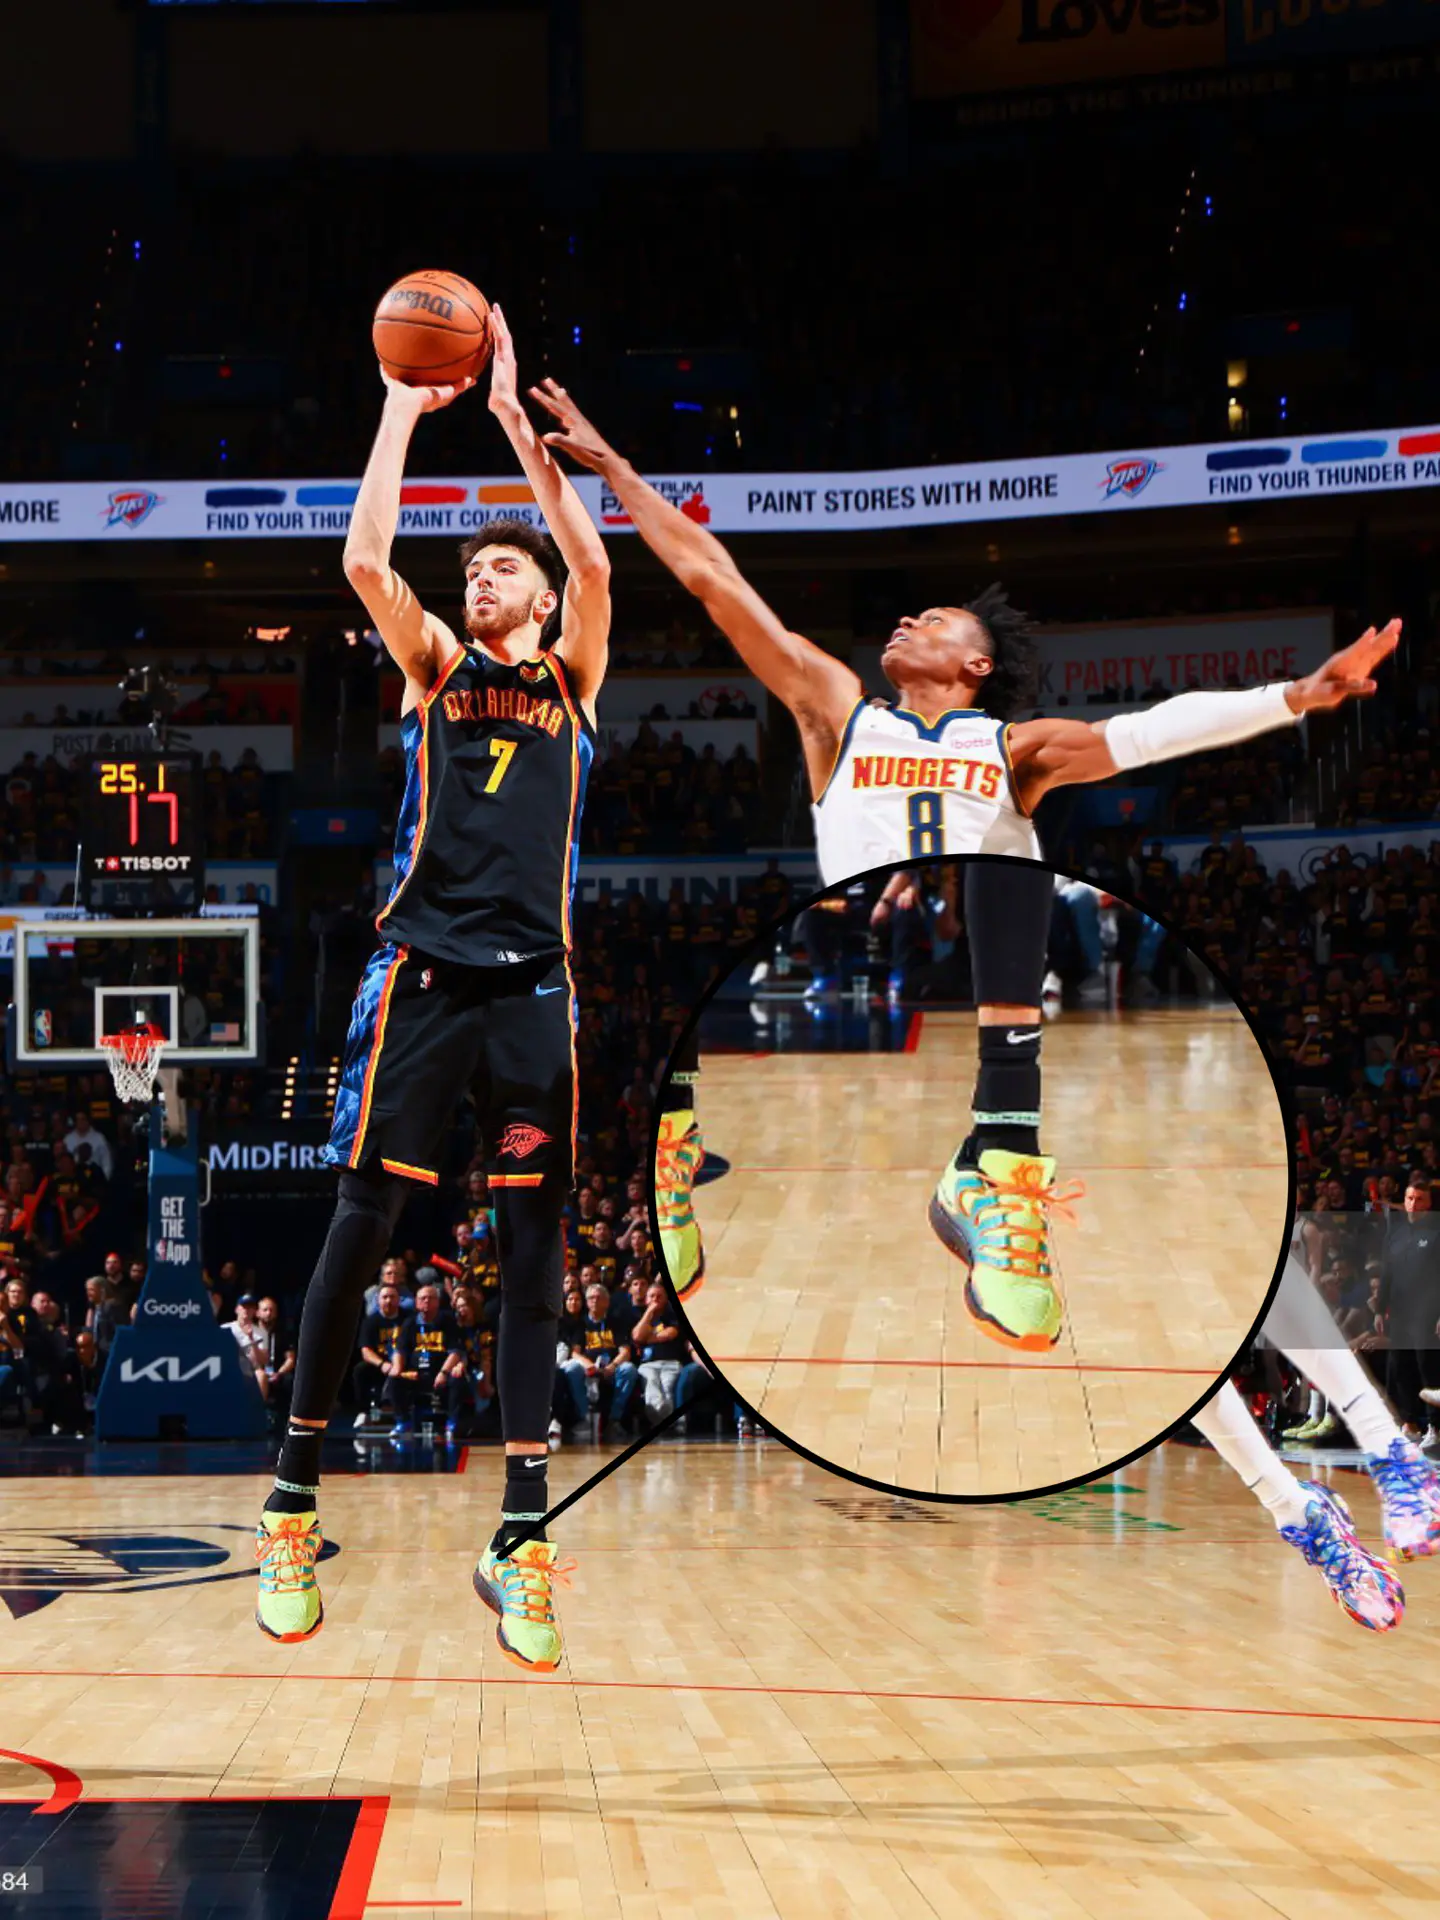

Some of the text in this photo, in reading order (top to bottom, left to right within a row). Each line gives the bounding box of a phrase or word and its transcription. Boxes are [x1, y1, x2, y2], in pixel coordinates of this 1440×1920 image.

[748, 473, 1058, 513] PAINT STORES WITH MORE
[1209, 474, 1252, 495] FIND
[1259, 469, 1310, 491] YOUR
[1316, 463, 1406, 486] THUNDER
[206, 511, 249, 531] FIND
[254, 511, 303, 529] YOUR
[401, 509, 454, 528] PAINT
[1064, 654, 1156, 692] PARTY
[1166, 647, 1299, 688] TERRACE
[442, 686, 564, 739] OKLAHOMA
[101, 763, 165, 794] 25.1
[484, 738, 518, 794] 7
[852, 756, 1002, 798] NUGGETS
[907, 791, 947, 860] 8
[121, 856, 191, 871] TISSOT
[161, 1197, 185, 1217] GET
[161, 1219, 185, 1238] THE
[166, 1240, 190, 1265] App
[144, 1299, 200, 1319] Google
